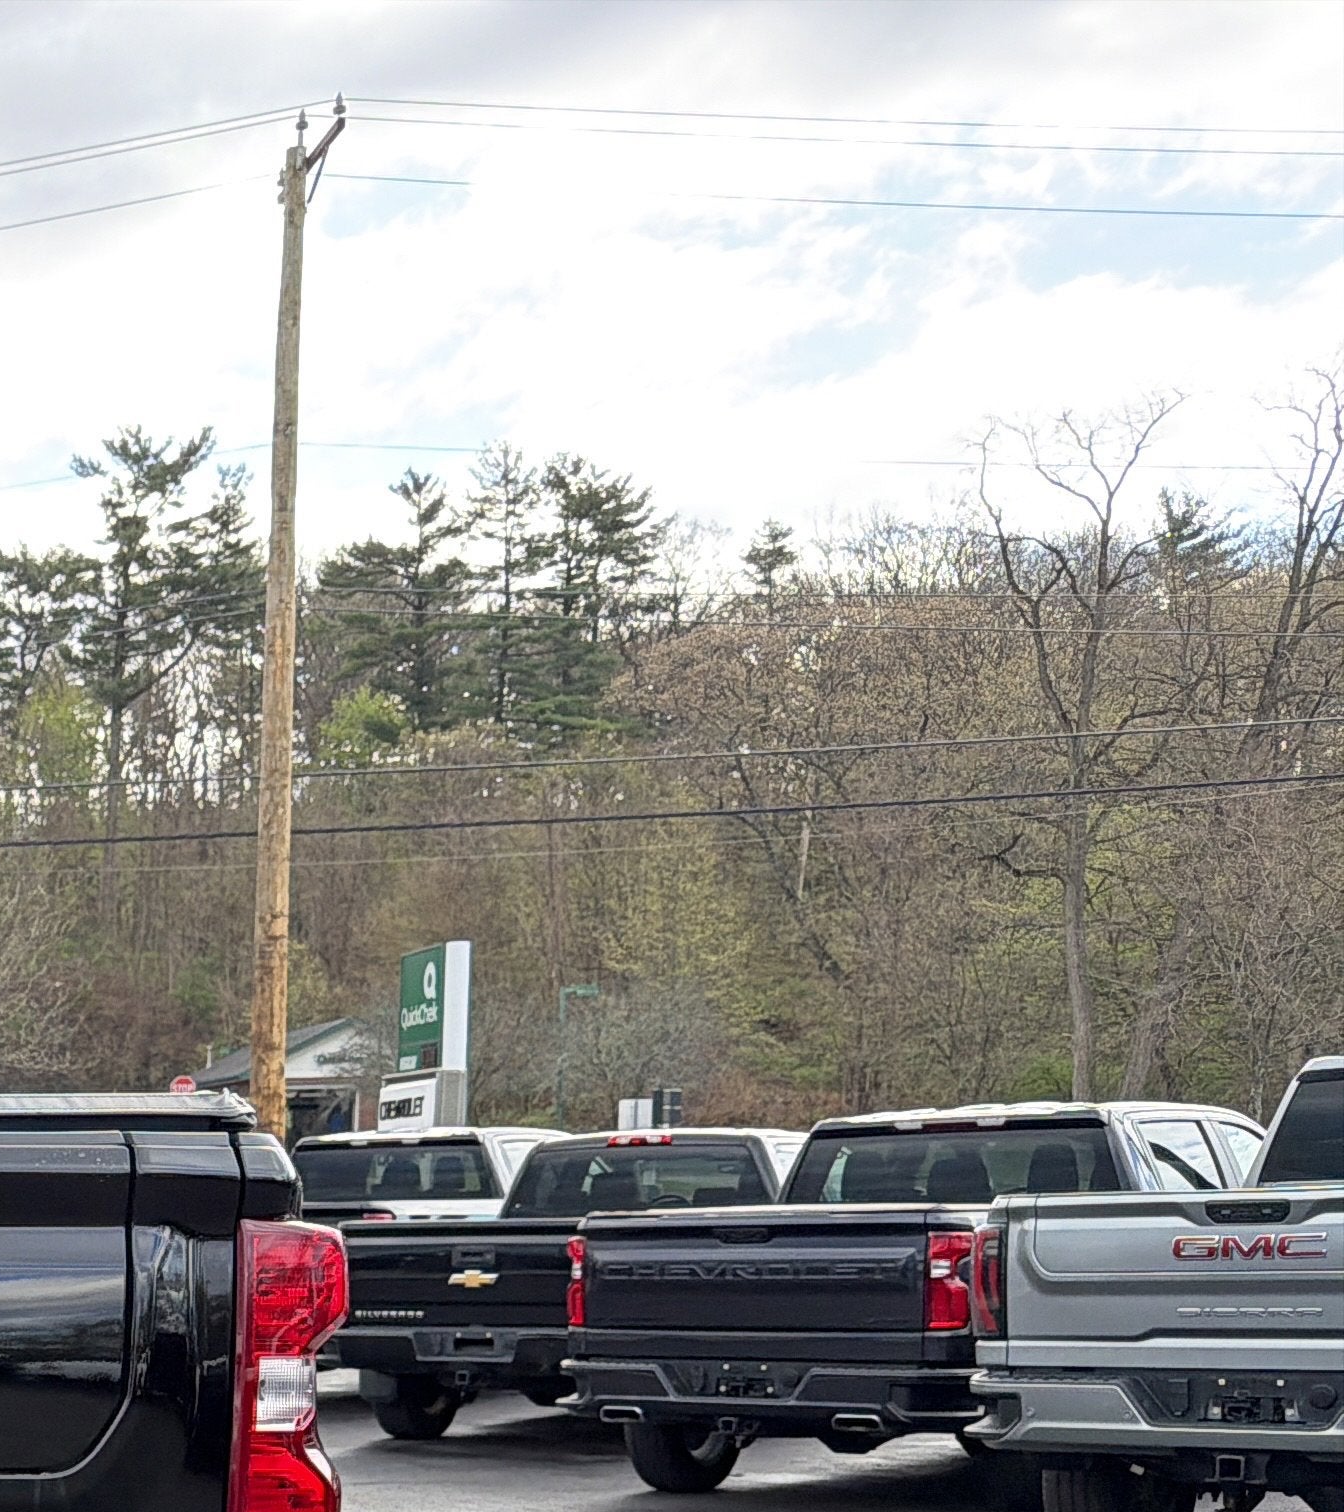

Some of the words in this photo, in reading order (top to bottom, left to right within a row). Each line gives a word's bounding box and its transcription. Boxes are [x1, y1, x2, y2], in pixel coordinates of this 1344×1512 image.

[400, 1001, 438, 1031] QuickChek
[1171, 1231, 1328, 1261] GMC
[600, 1261, 906, 1281] CHEVROLET
[354, 1308, 426, 1320] SILVERADO
